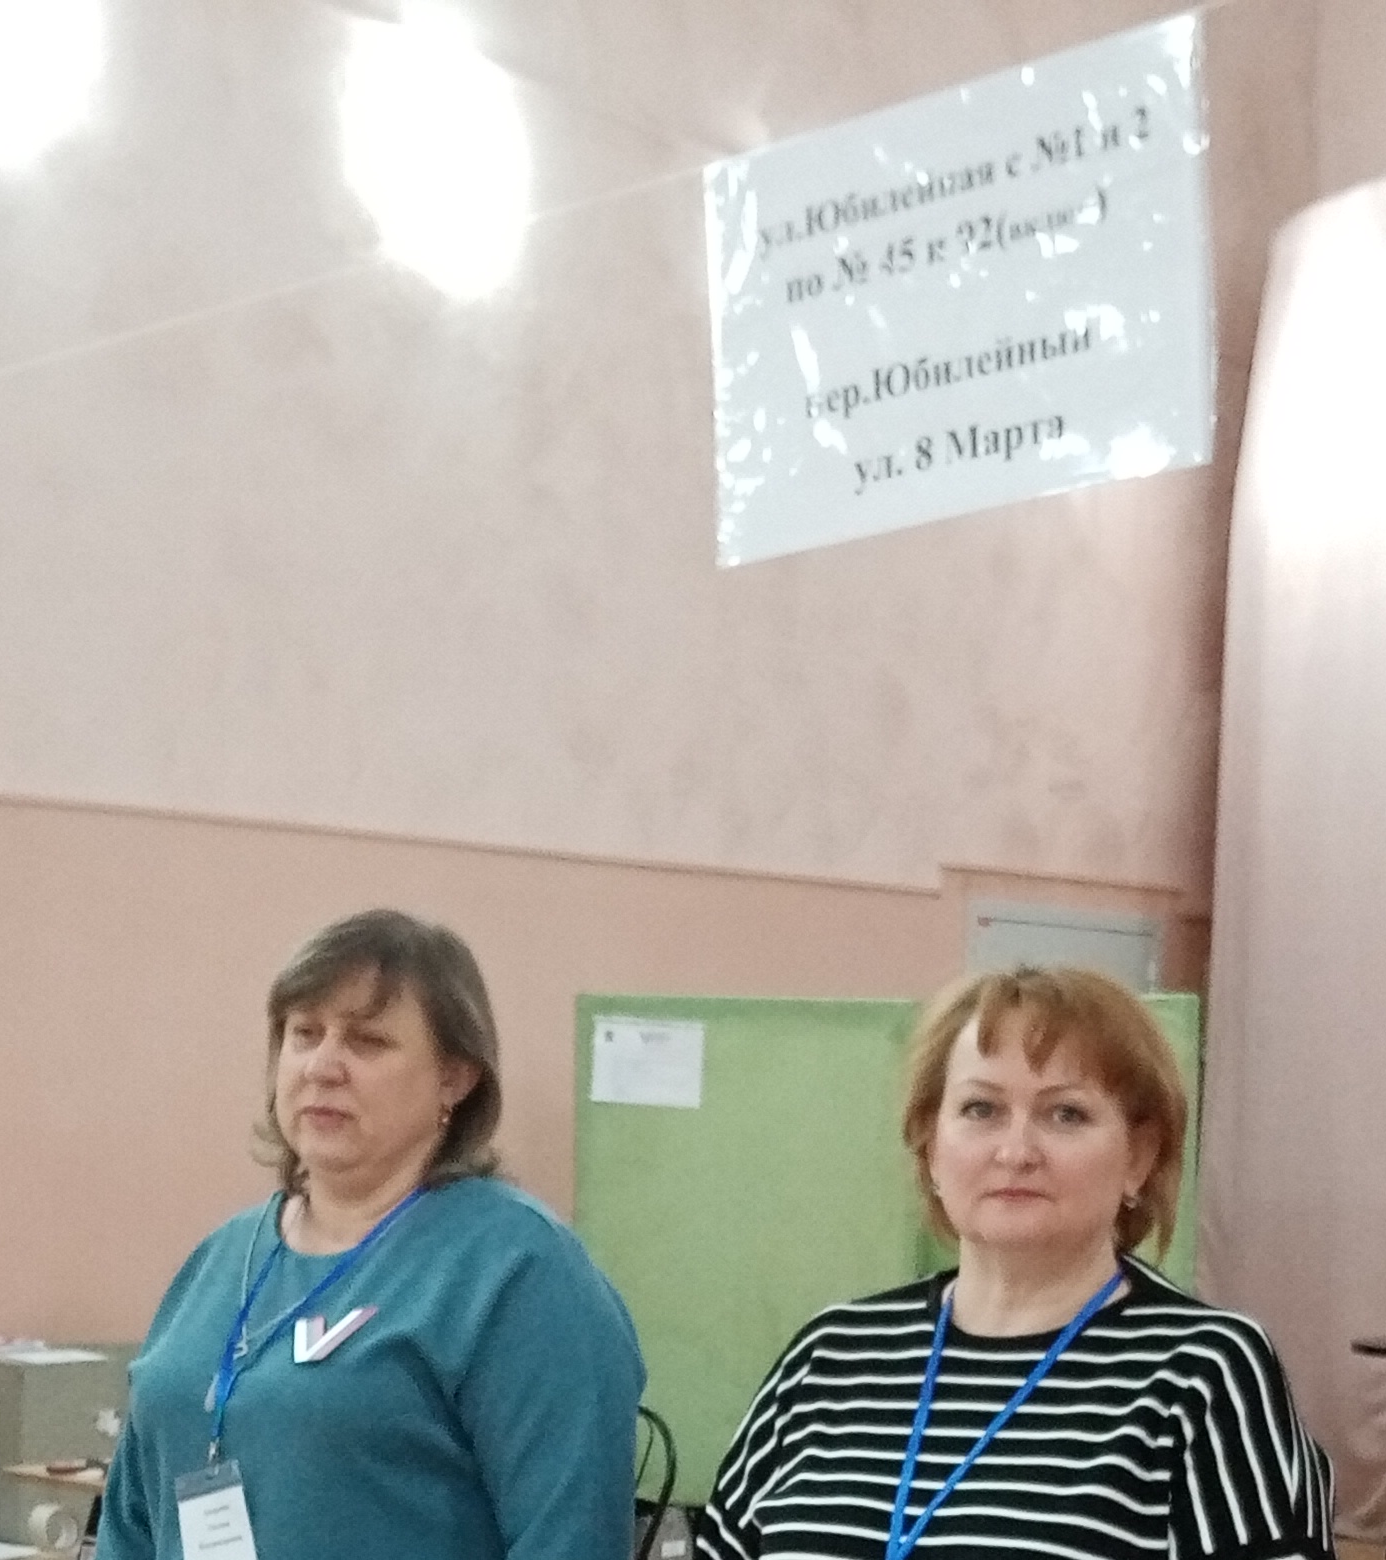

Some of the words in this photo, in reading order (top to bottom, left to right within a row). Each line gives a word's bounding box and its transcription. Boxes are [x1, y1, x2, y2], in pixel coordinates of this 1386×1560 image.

[786, 272, 825, 304] по
[853, 455, 904, 497] ул.
[915, 435, 934, 472] 8
[945, 415, 1065, 463] Марта
